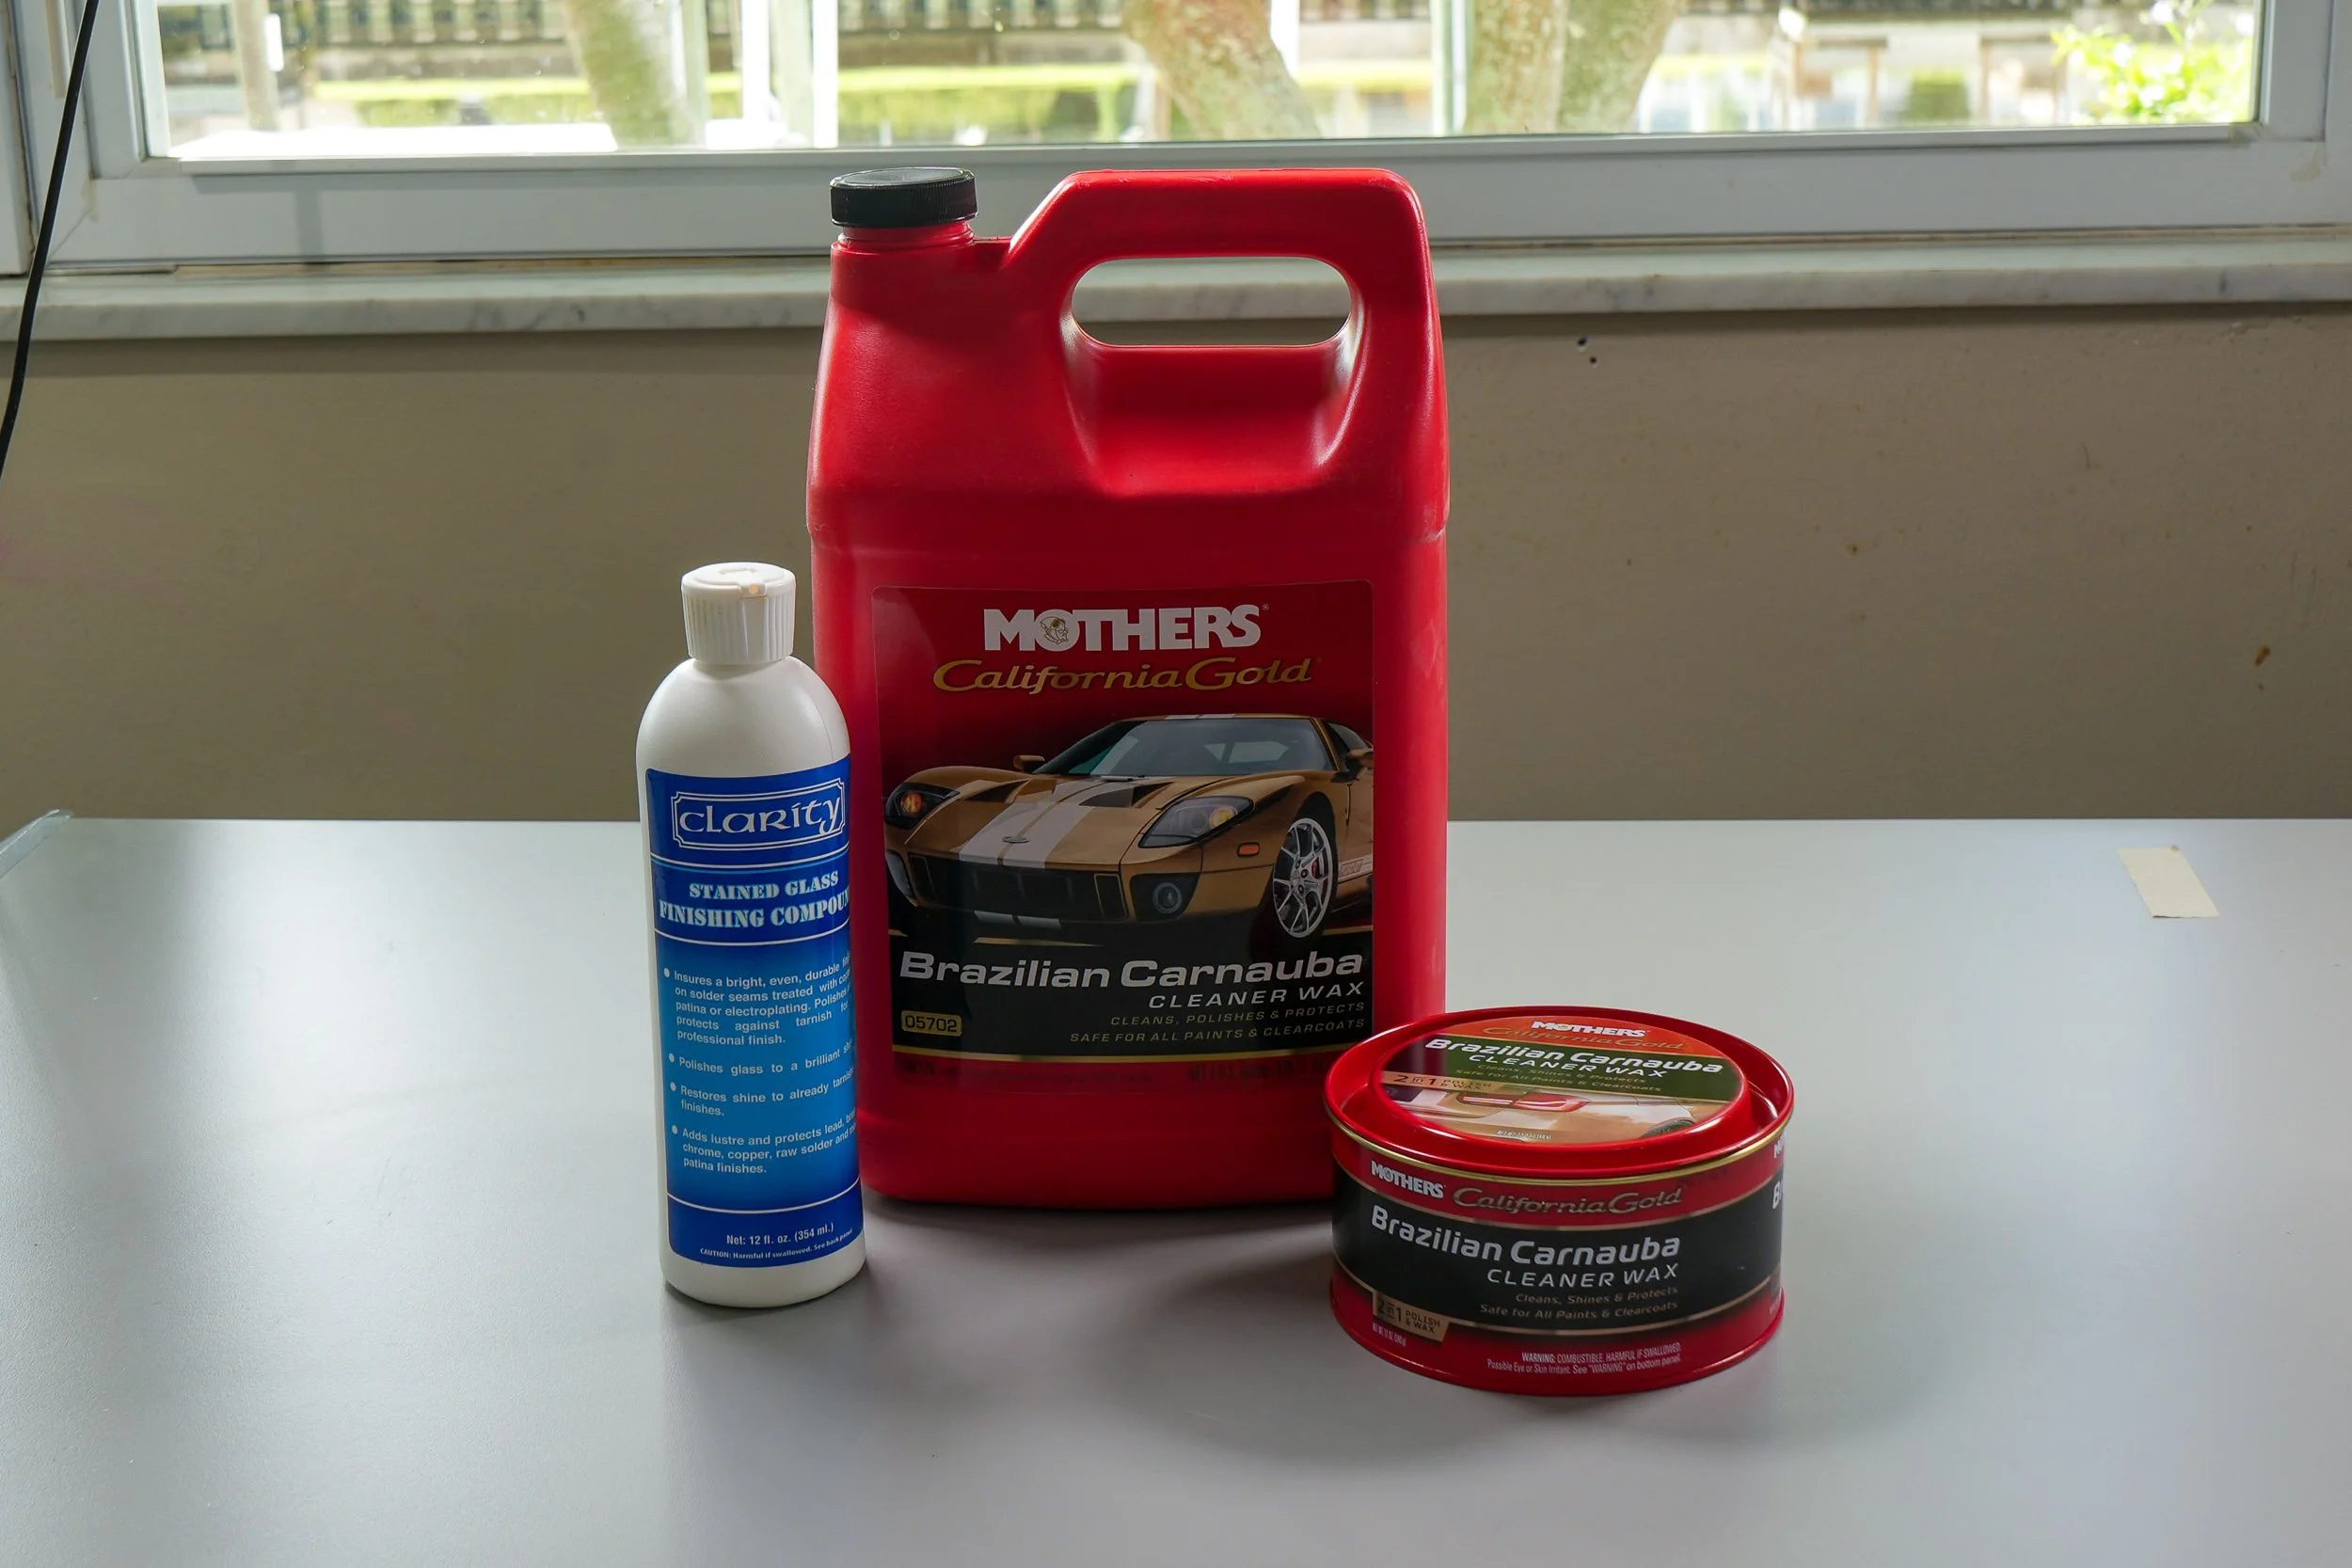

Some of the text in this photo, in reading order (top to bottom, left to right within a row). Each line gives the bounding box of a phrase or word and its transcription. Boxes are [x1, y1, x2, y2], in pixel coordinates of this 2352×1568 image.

[932, 657, 1313, 695] California Gold
[679, 796, 840, 835] clarity
[690, 870, 838, 900] STAINED GLASS
[660, 898, 764, 927] FINISHING
[675, 971, 712, 987] Insures
[716, 978, 723, 987] a
[726, 976, 766, 989] bright,
[770, 975, 802, 986] even,
[805, 963, 839, 981] durable
[900, 950, 1364, 988] Brazilian Carnauba
[675, 987, 687, 997] on
[690, 990, 724, 1002] solder
[728, 991, 769, 1003] seams
[772, 985, 813, 1000] treated
[819, 978, 837, 992] with
[1149, 981, 1364, 1009] CLEANER WAX
[675, 1002, 707, 1015] patina
[709, 1006, 722, 1016] or
[724, 1003, 811, 1018] electroplating.
[676, 1016, 719, 1031] protects
[735, 1020, 780, 1034] against
[796, 1010, 833, 1027] tarnish
[1111, 1002, 1365, 1026] CLEANS, POLISHES & PROTECTS
[904, 1014, 958, 1033] 05702
[1070, 1019, 1365, 1043] SAFE FOR ALL PAINTS & CLEARCOATS
[677, 1030, 786, 1046] professional finish.
[679, 1049, 841, 1077] Polishes glass to a brilliant
[1424, 1038, 1724, 1073] Brazilian Carnauba
[1469, 1054, 1668, 1078] CLEANER WAX
[1393, 1074, 1408, 1083] 2
[1530, 1069, 1571, 1078] Shines
[1589, 1074, 1646, 1084] Protects
[1533, 1075, 1573, 1084] Paints
[680, 1085, 726, 1102] Restores
[733, 1093, 766, 1103] shine
[771, 1091, 784, 1101] to
[789, 1083, 829, 1100] already
[681, 1101, 724, 1117] finishes.
[682, 1128, 707, 1143] Adds
[711, 1133, 744, 1147] lustre
[748, 1134, 771, 1146] and
[774, 1129, 821, 1146] protects
[824, 1118, 845, 1135] lead,
[682, 1131, 849, 1161] chrome, copper, raw solder and
[683, 1158, 767, 1174] patina finishes.
[1371, 1160, 1445, 1199] MOTHERS
[1453, 1187, 1685, 1214] California Gold
[726, 1234, 746, 1245] Net:
[749, 1235, 761, 1245] 12
[794, 1227, 815, 1243] (354
[1371, 1204, 1681, 1266] Brazilian Carnauba
[1486, 1262, 1679, 1288] CLEANER WAX
[1516, 1293, 1563, 1305] Cleans,
[1566, 1294, 1611, 1305] Shines
[1627, 1286, 1678, 1301] Protects
[1405, 1310, 1440, 1327] POLISH
[1480, 1304, 1508, 1315] Safe
[1512, 1307, 1531, 1317] for
[1534, 1309, 1552, 1319] All
[1555, 1309, 1597, 1320] Paints
[1614, 1302, 1678, 1317] Clearcoats
[1414, 1321, 1436, 1334] WAX
